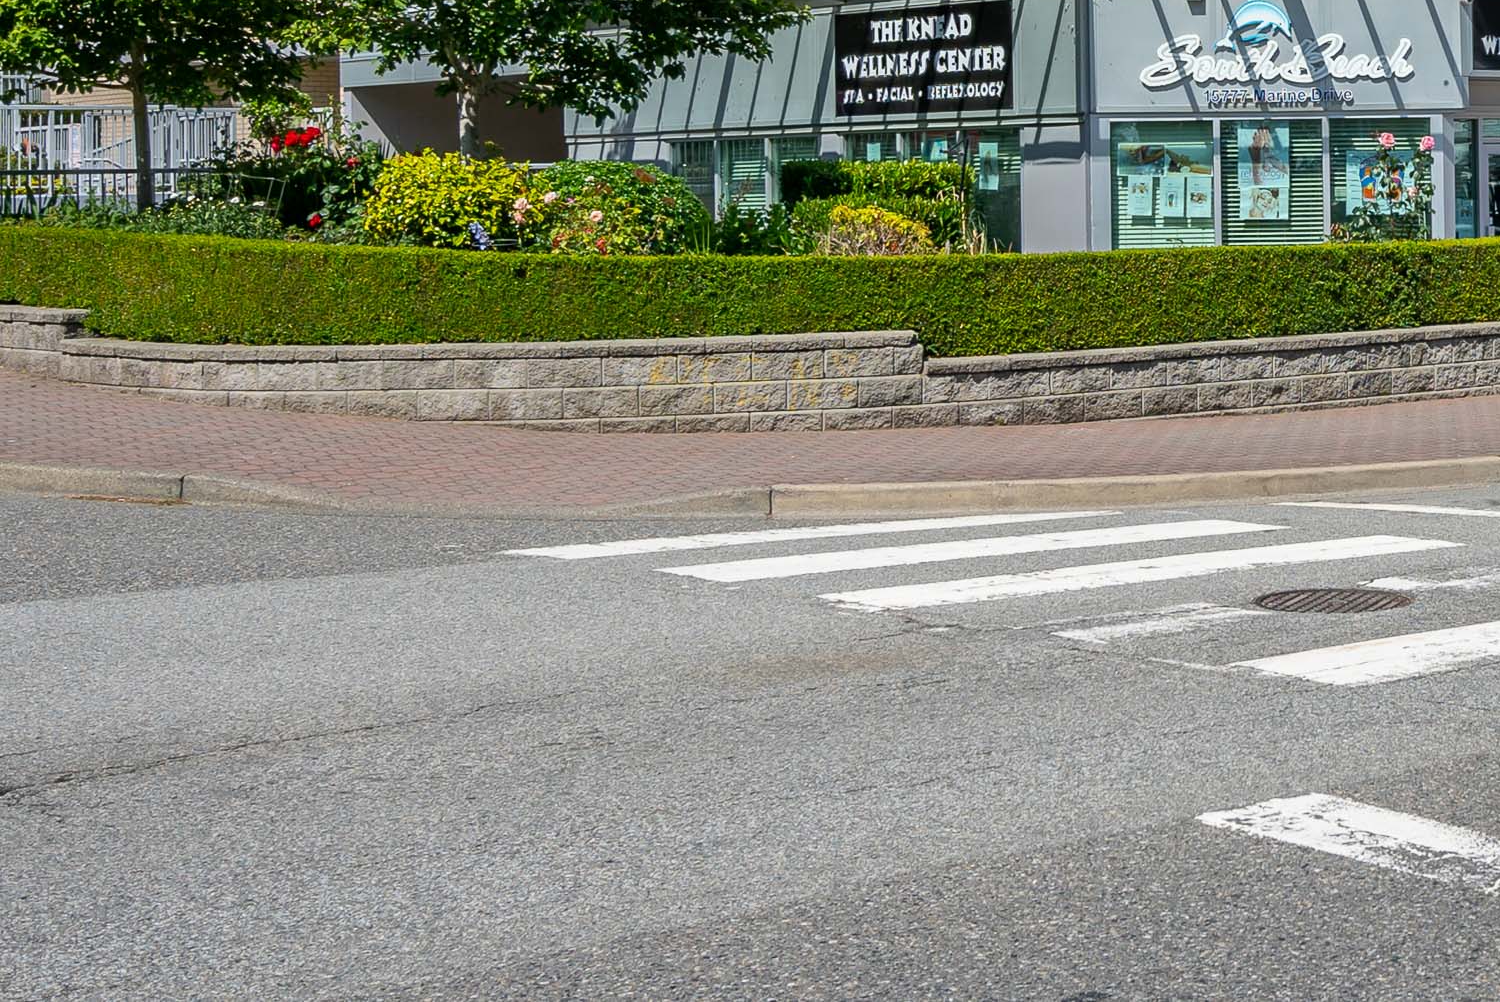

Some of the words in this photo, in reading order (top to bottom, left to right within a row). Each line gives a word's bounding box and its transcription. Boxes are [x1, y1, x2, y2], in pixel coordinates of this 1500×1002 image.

[870, 18, 903, 43] THE
[907, 13, 972, 41] KNEAD
[841, 50, 930, 79] WELLNESS
[936, 45, 1006, 73] CENTER
[1140, 34, 1279, 87] South
[1281, 33, 1415, 83] Beach
[843, 87, 865, 104] SPA
[876, 86, 915, 102] FACIAL
[927, 81, 1004, 100] REFLEXOLOGY
[1203, 88, 1248, 104] 15777
[1253, 88, 1306, 103] Marine
[1311, 86, 1353, 102] Drive
